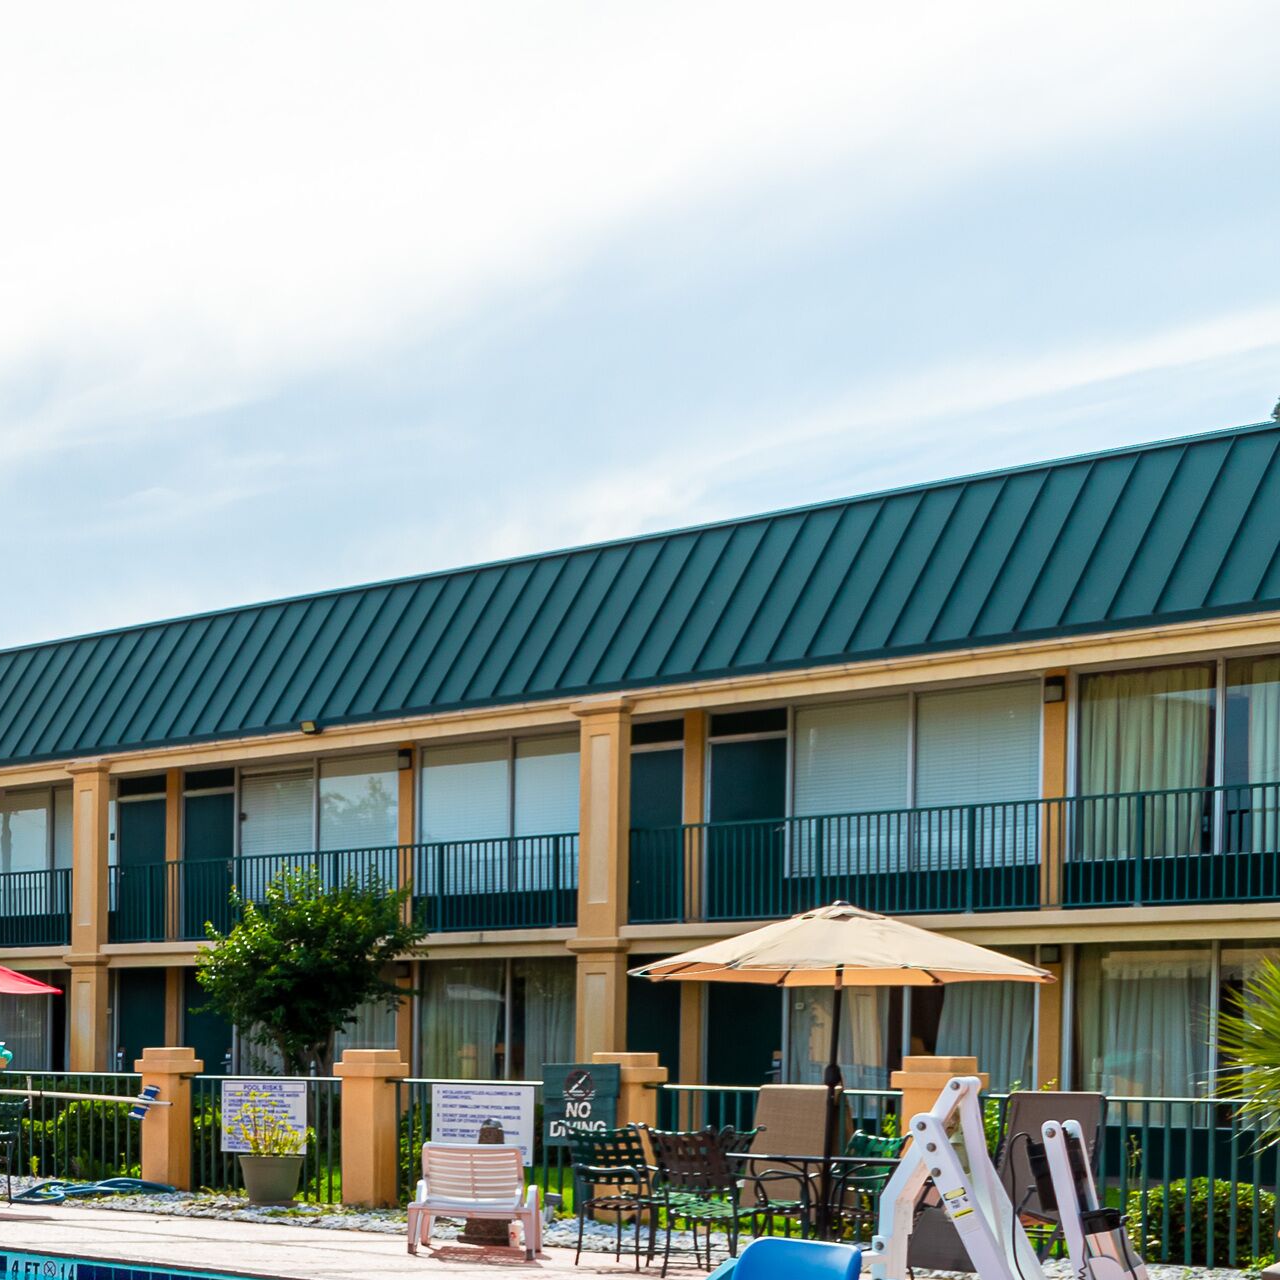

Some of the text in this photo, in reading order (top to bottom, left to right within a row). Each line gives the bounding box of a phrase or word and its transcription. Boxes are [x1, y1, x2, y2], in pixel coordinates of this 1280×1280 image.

[565, 1101, 592, 1118] NO
[11, 1260, 19, 1277] 4
[24, 1261, 40, 1277] FT
